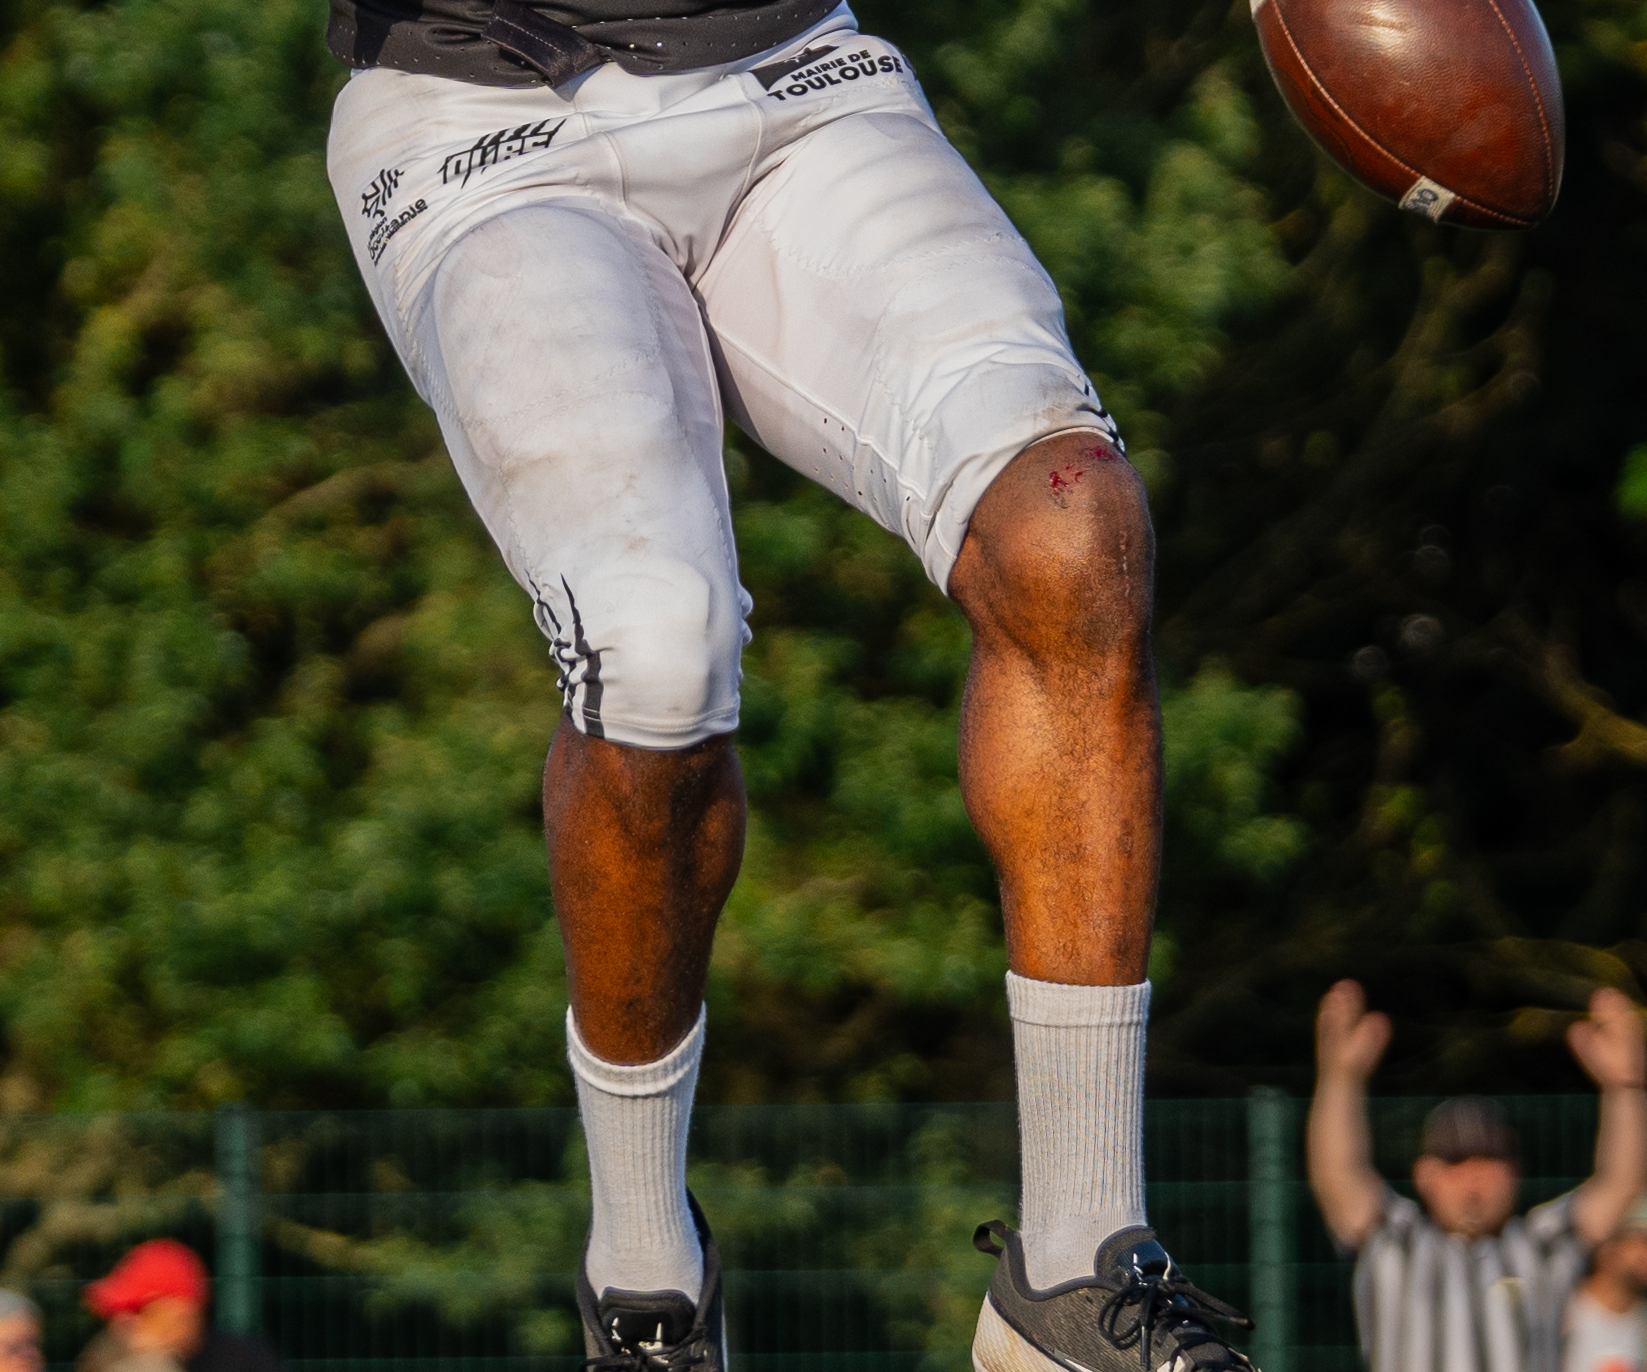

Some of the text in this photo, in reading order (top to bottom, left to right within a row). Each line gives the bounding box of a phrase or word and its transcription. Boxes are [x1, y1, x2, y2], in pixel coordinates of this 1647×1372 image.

[767, 55, 904, 101] TOULOUSE
[791, 49, 872, 82] MAIRIE DE
